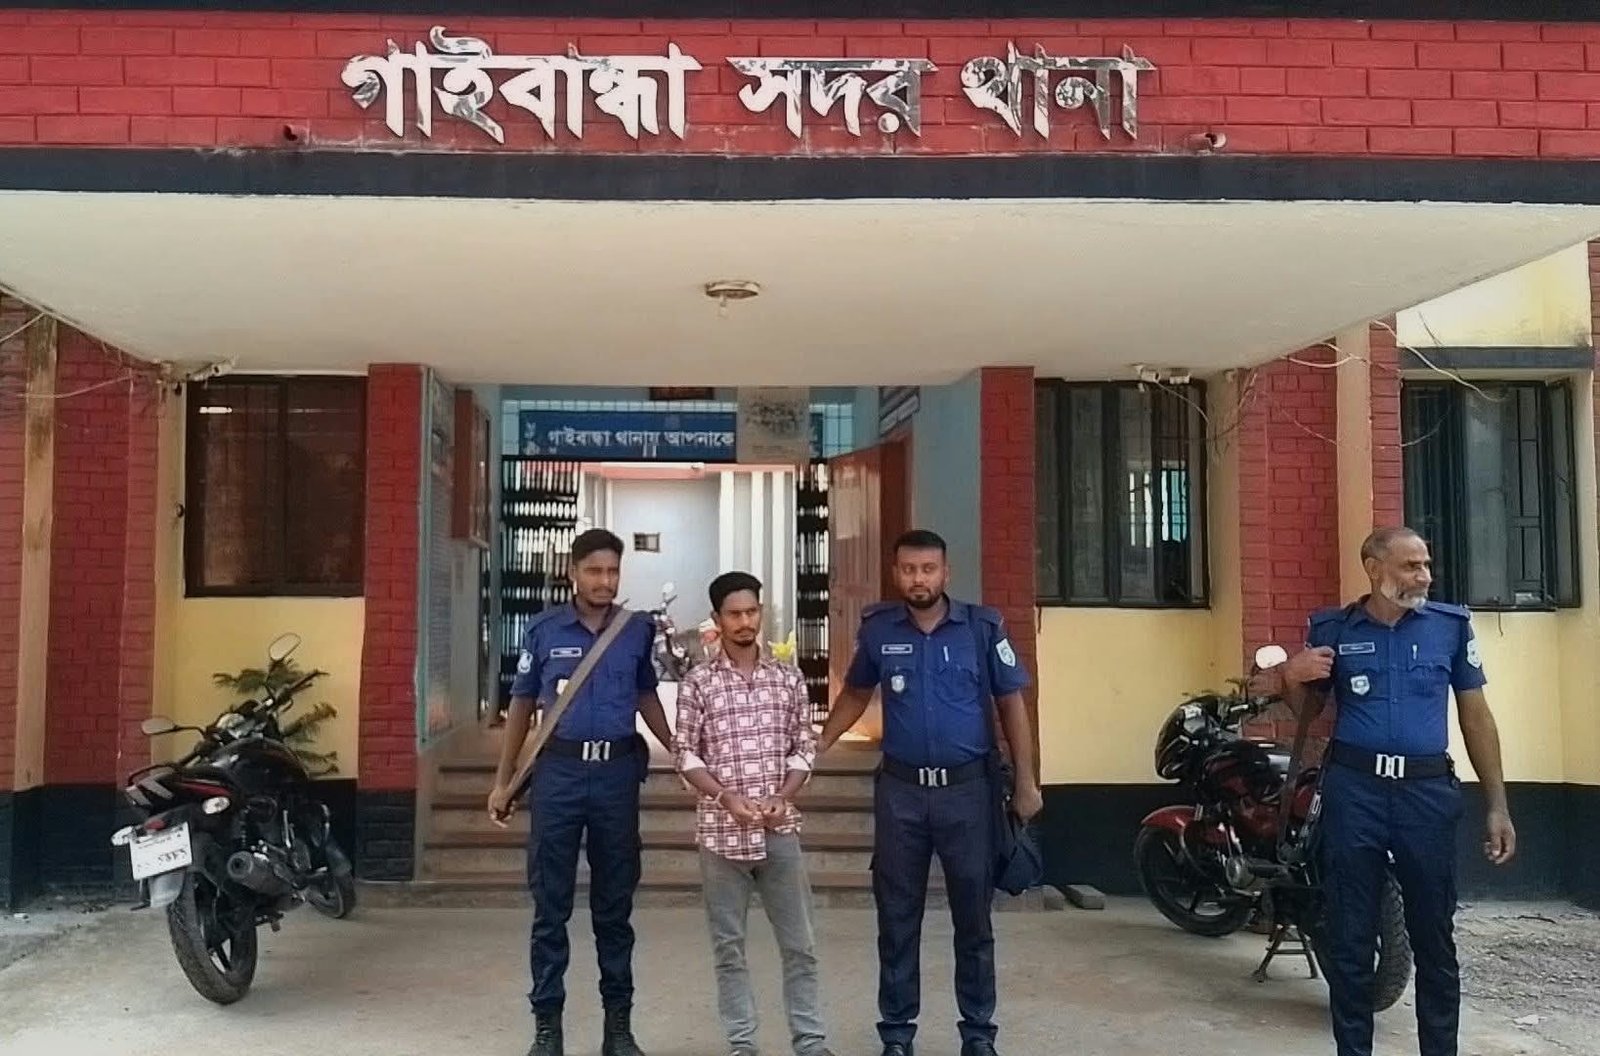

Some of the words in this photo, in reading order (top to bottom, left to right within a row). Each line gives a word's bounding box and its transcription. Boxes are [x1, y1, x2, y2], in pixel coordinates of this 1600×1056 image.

[340, 25, 703, 145] গাইবান্ধা
[725, 56, 939, 138] সদর
[959, 40, 1157, 141] থানা
